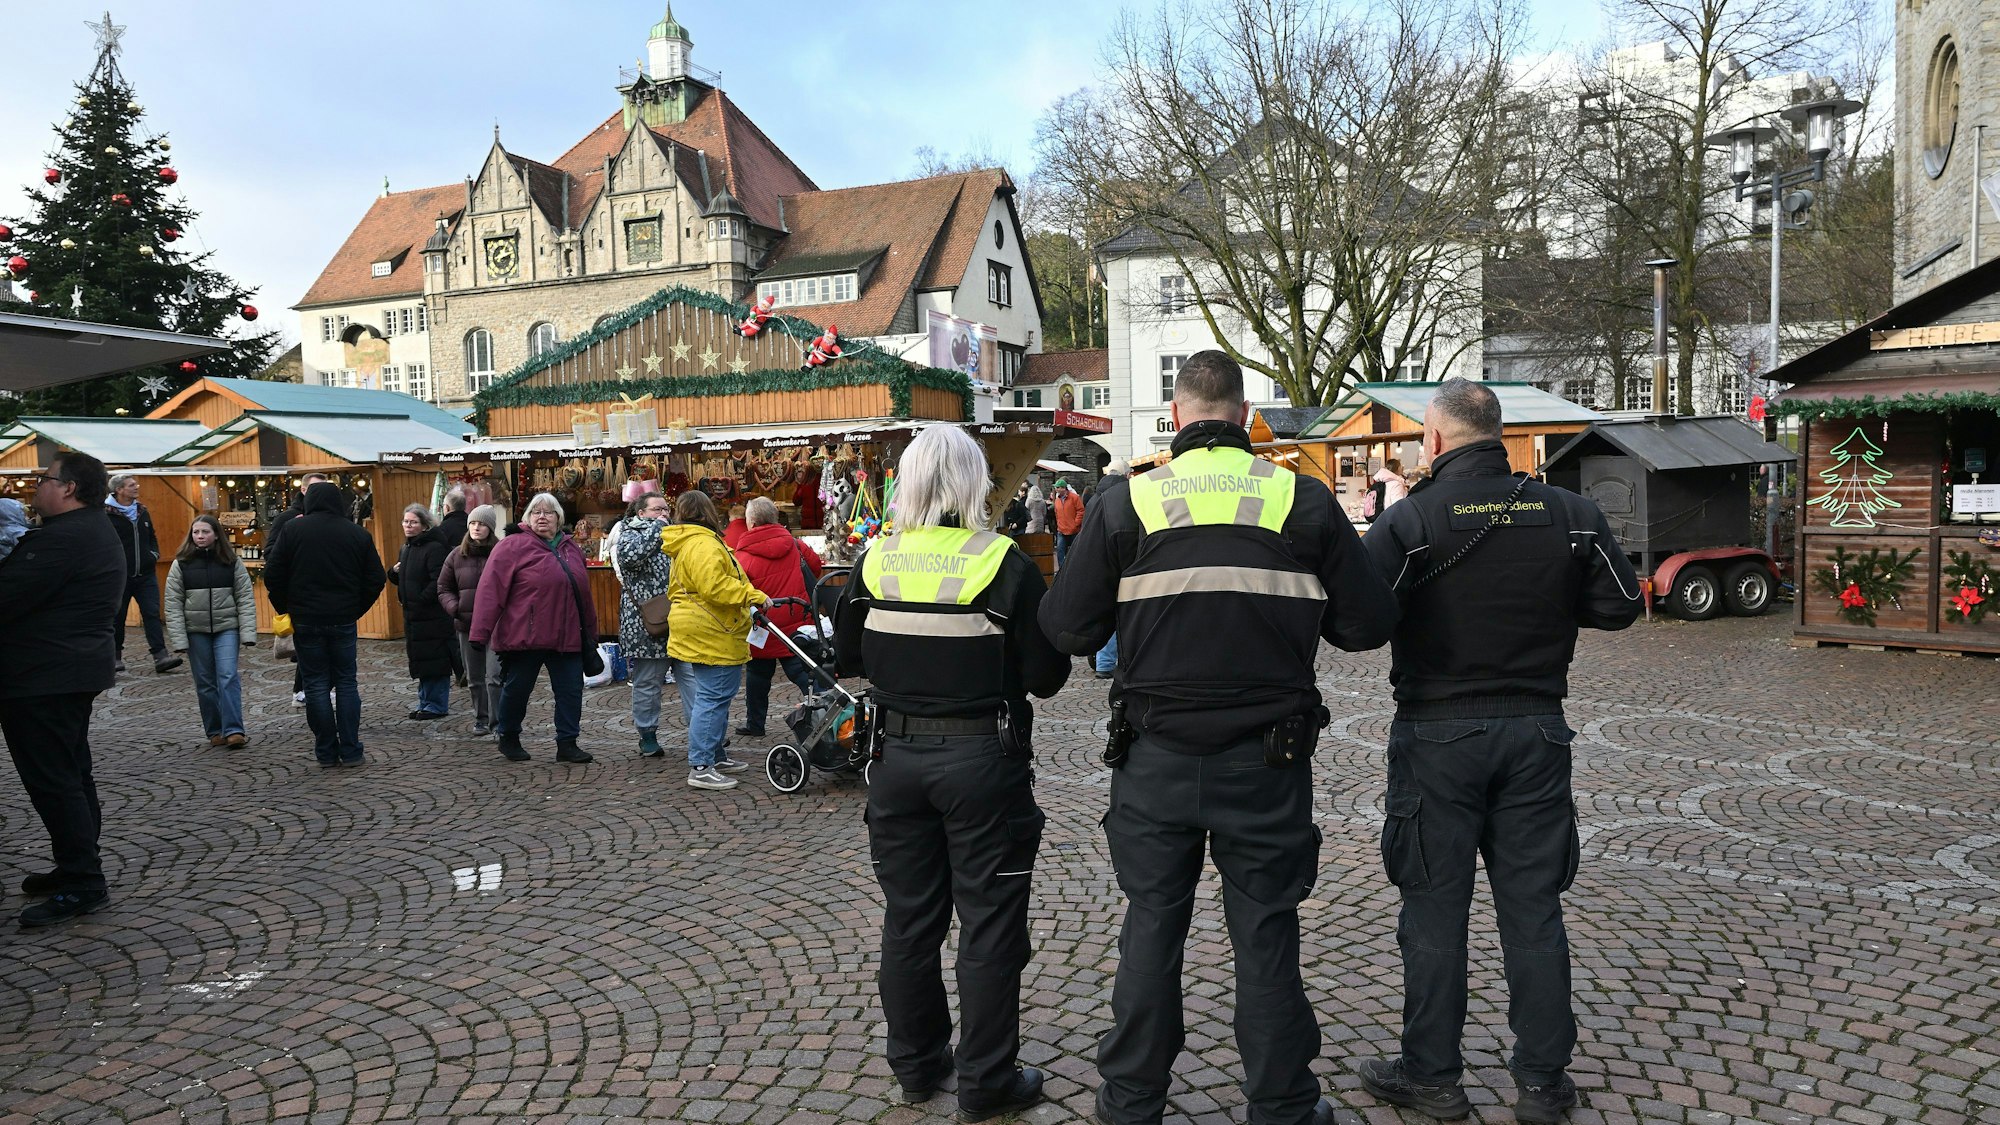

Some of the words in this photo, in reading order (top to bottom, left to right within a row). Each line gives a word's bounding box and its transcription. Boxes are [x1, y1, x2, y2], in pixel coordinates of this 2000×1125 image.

[1066, 413, 1105, 430] SCHASCHLIK
[1157, 417, 1176, 433] Ga
[911, 428, 923, 437] Er
[980, 425, 1005, 433] Mandeln
[843, 433, 872, 442] Herzen
[700, 443, 732, 451] Mandeln
[762, 438, 810, 447] Cashewkerne
[558, 448, 603, 458] Paradiesäpfel
[630, 446, 672, 455] Zuckerwatte
[438, 454, 465, 462] Mandeln
[489, 452, 532, 461] Schokofrüchte
[1161, 474, 1262, 497] ORDNUNGSAMT
[1453, 500, 1546, 515] Sicherheisdienst
[881, 552, 968, 575] ORDNUNGSAMT
